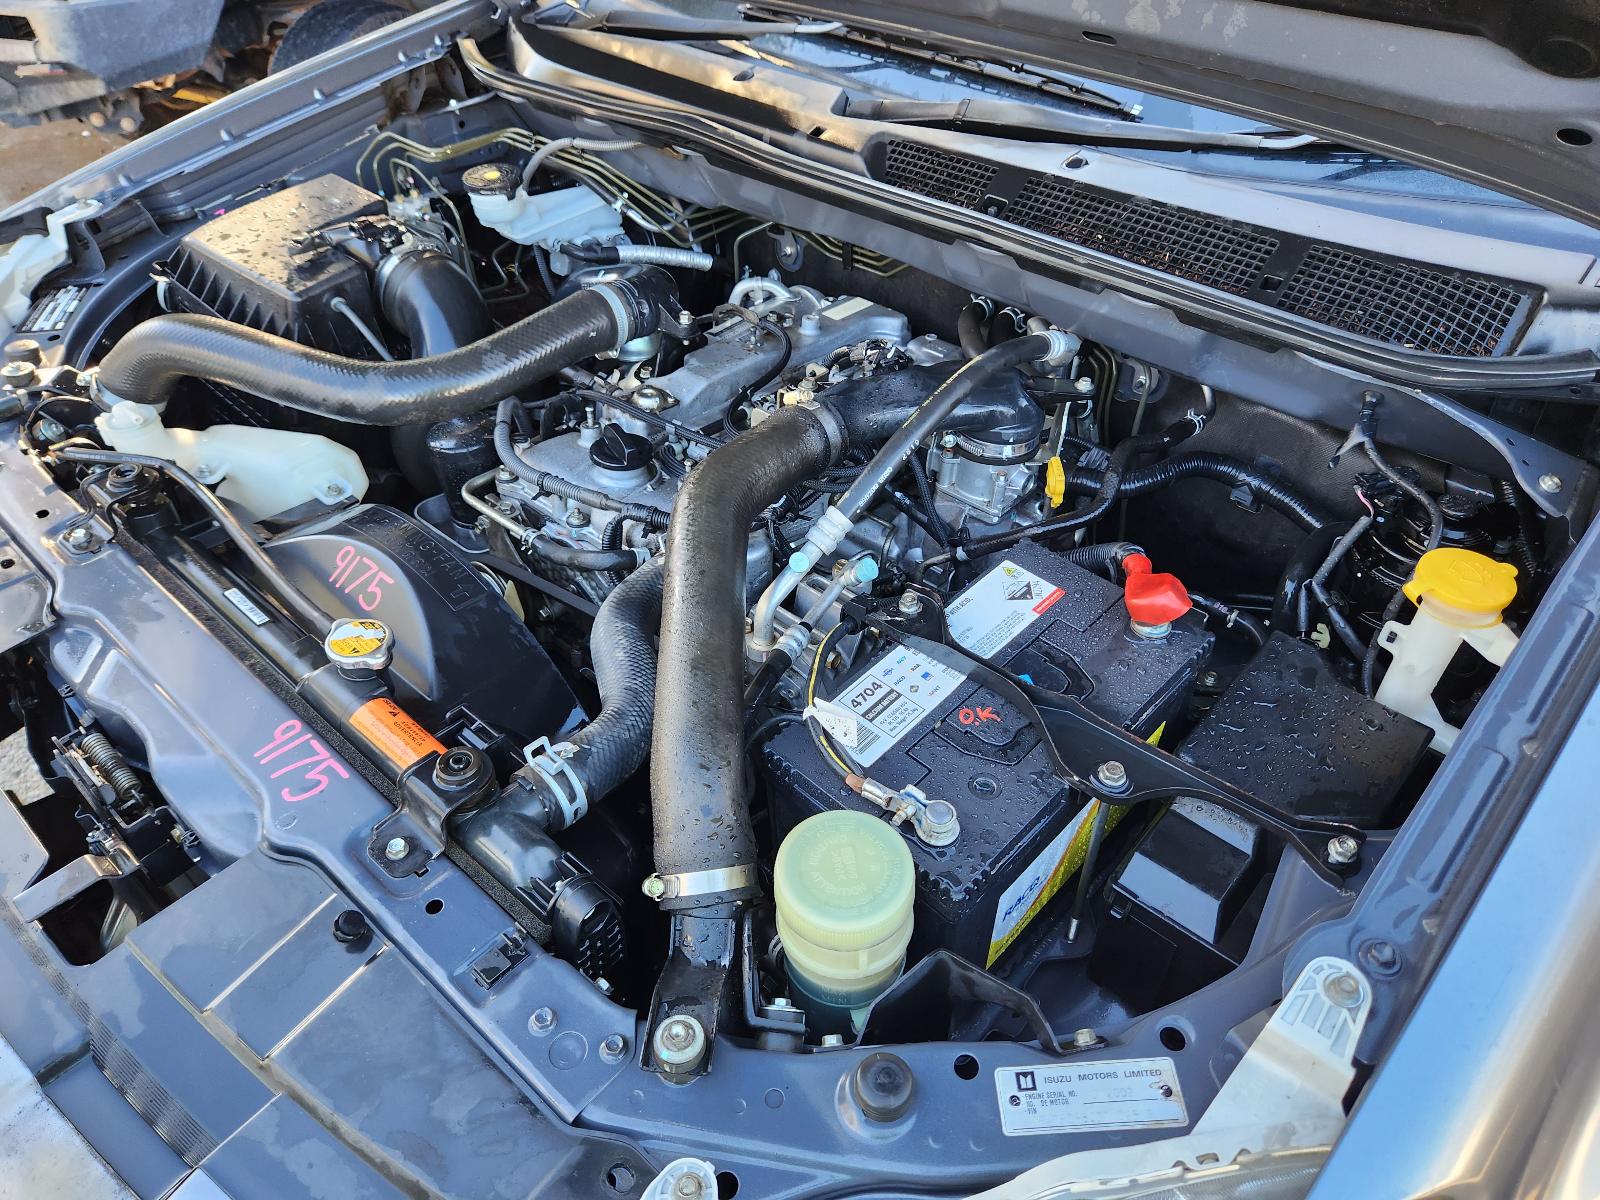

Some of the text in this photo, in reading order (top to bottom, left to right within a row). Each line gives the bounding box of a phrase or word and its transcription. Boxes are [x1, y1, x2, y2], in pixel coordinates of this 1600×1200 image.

[328, 545, 395, 612] 9175
[850, 681, 884, 710] 4704
[253, 719, 350, 802] 9175
[1044, 1069, 1162, 1084] ISUZU MOTORS LIMITED
[1025, 1092, 1045, 1100] ENGINE
[1046, 1091, 1067, 1099] SERIAL
